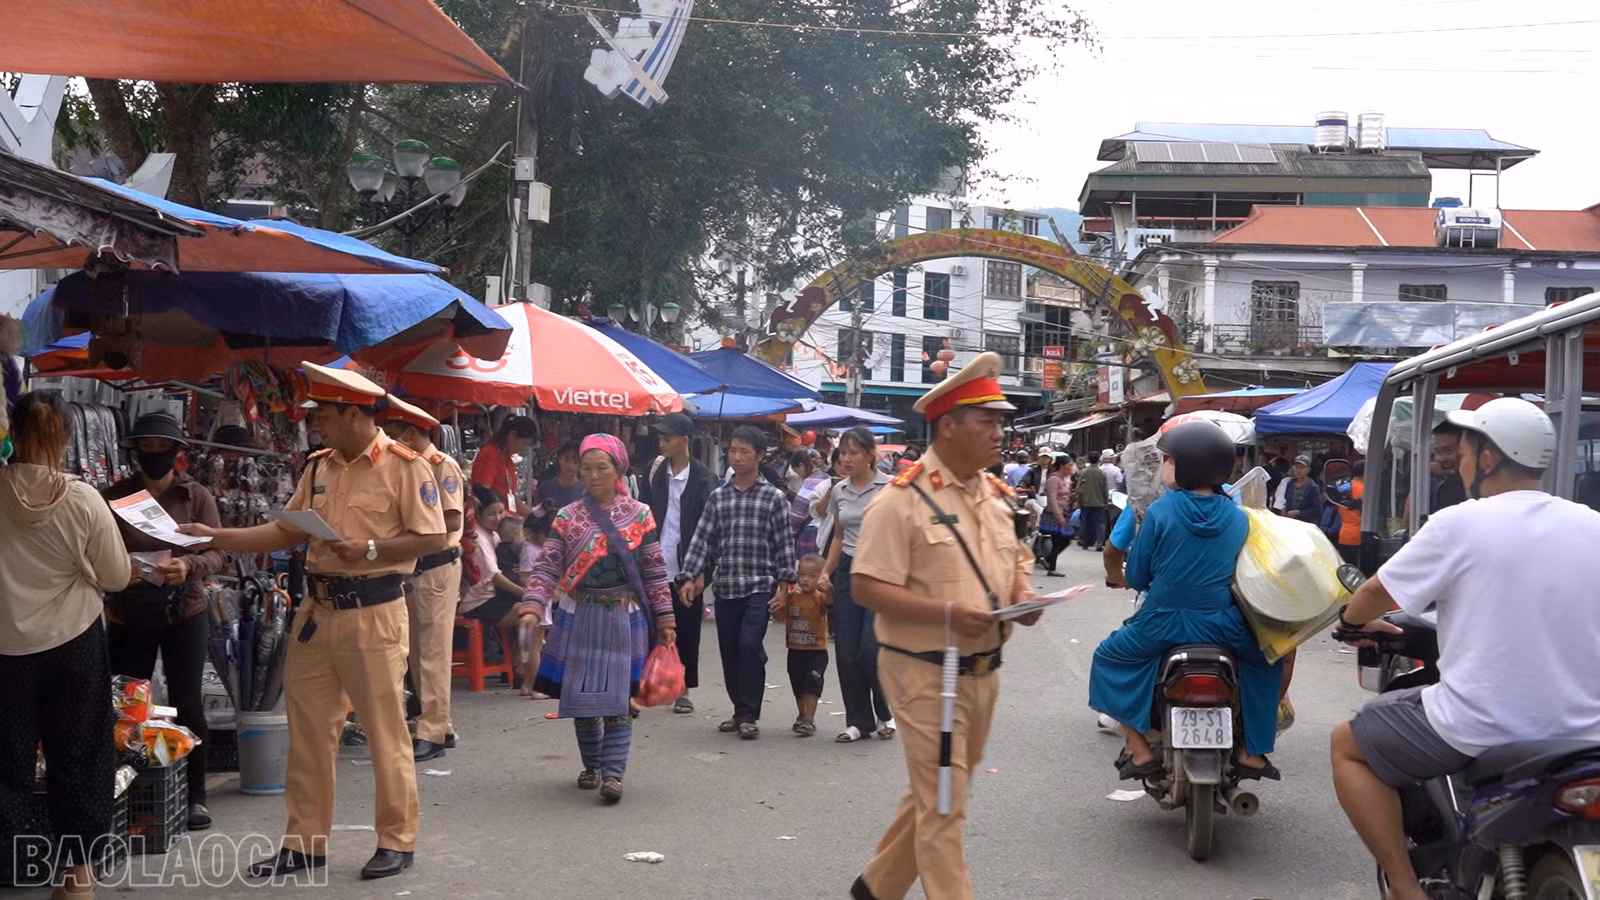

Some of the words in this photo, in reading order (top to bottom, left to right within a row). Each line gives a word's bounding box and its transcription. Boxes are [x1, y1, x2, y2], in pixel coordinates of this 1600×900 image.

[552, 387, 633, 409] viettel
[1181, 710, 1223, 727] 29-S1
[1181, 728, 1224, 745] 2648
